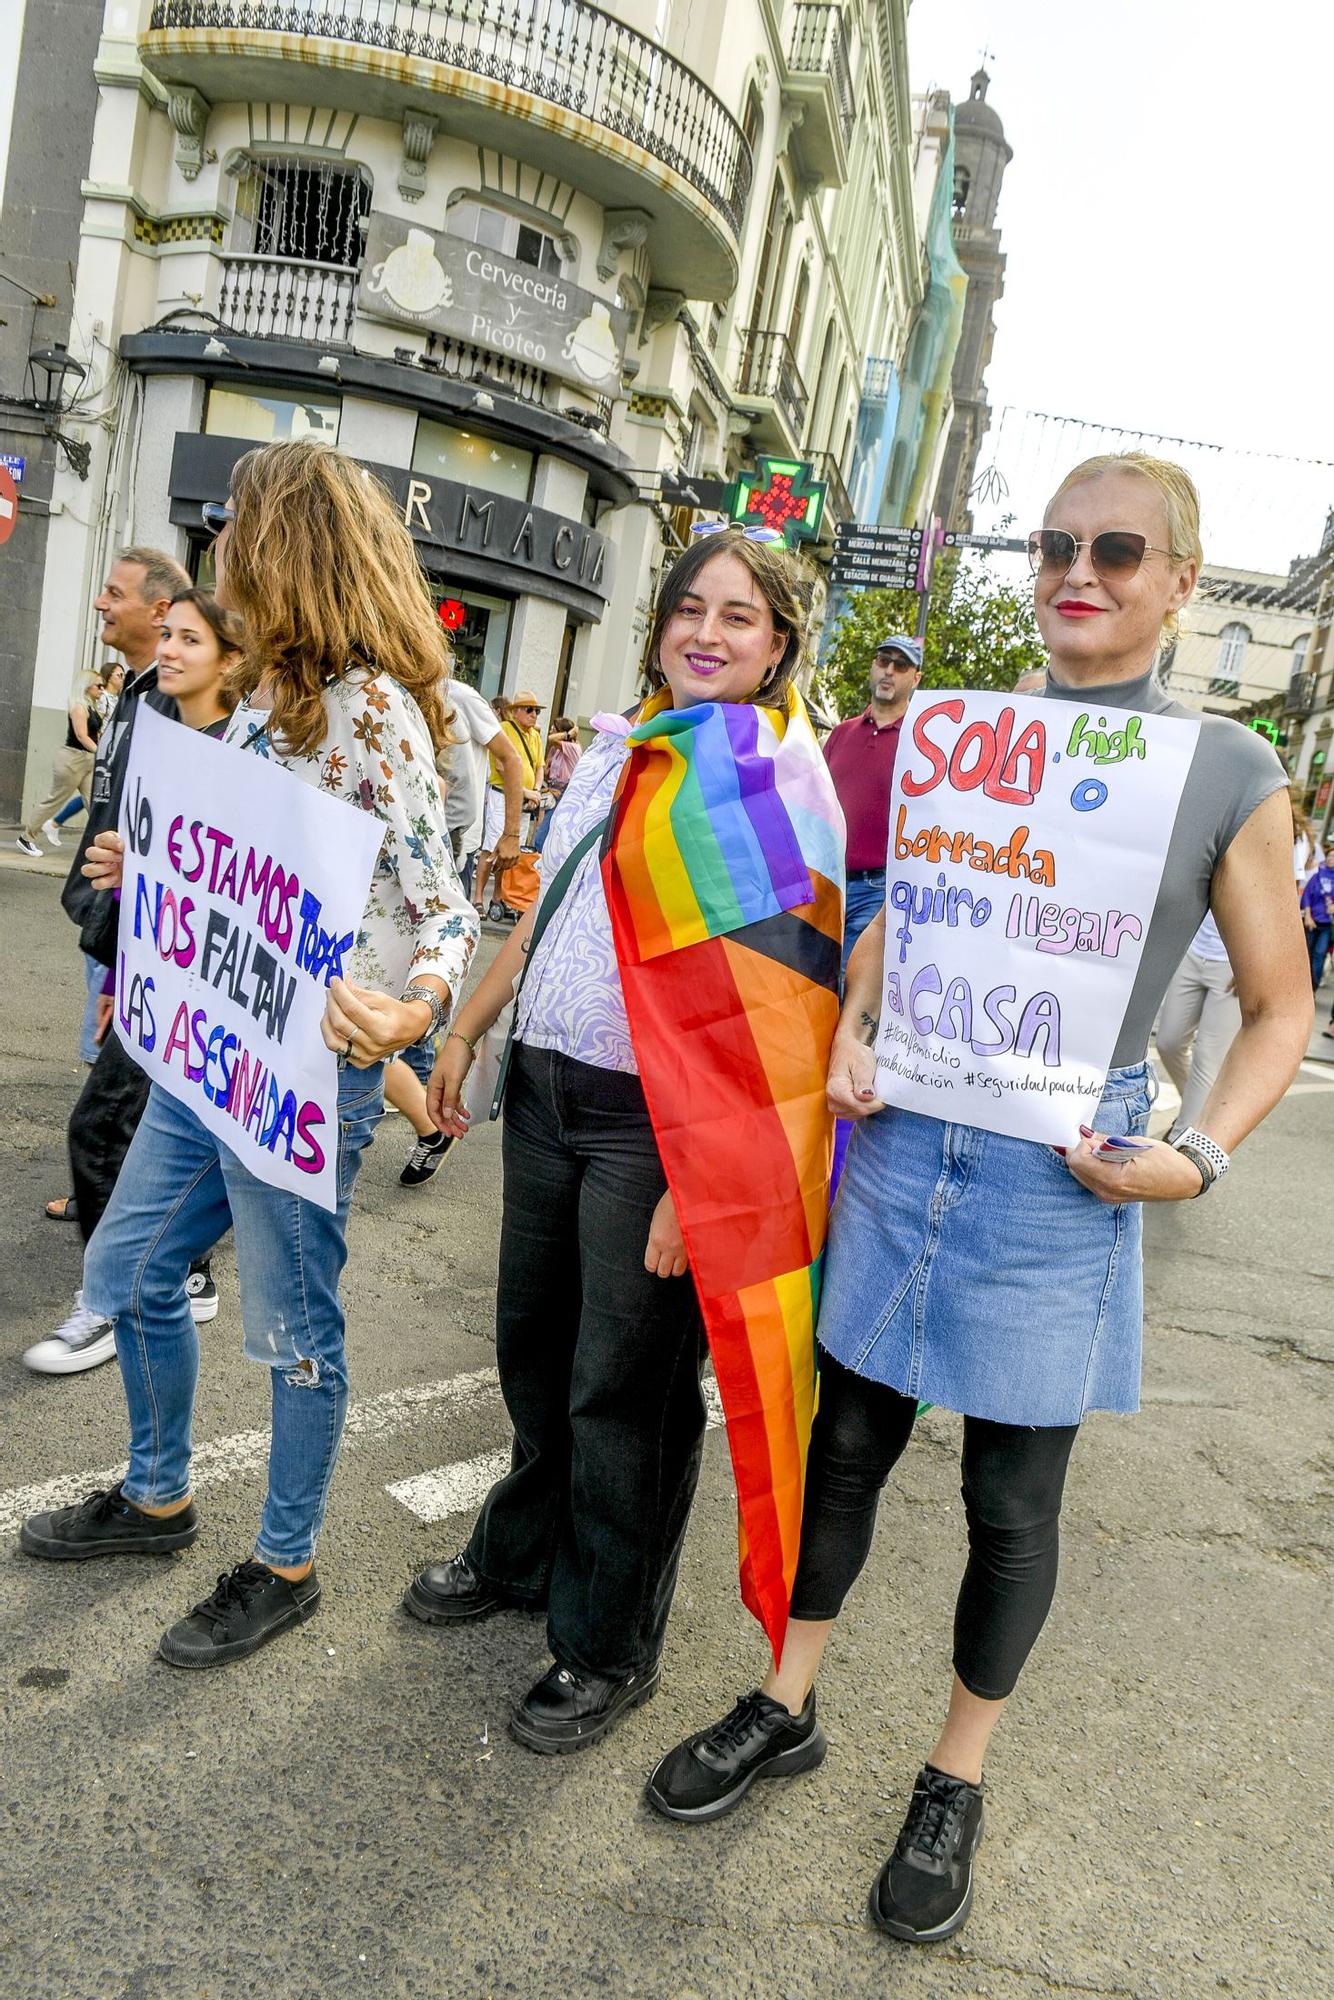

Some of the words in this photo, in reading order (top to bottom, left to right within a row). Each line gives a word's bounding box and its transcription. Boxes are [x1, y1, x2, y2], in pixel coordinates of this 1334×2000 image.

[471, 314, 546, 362] Picoteo
[505, 302, 521, 326] y
[404, 479, 607, 584] RMACIA
[852, 556, 871, 565] CALLE
[875, 542, 883, 551] DE
[871, 573, 878, 582] DE
[1065, 713, 1146, 765] high
[124, 775, 153, 857] NO
[168, 814, 299, 954] ESTAMOS
[294, 887, 354, 989] TODAS
[895, 803, 1056, 887] borracha
[133, 872, 196, 969] NOS
[200, 908, 298, 1046] FALTAN
[891, 872, 992, 963] quiro
[1005, 893, 1142, 958] llegar
[119, 950, 156, 1054] LAS
[909, 963, 1061, 1067] CASA
